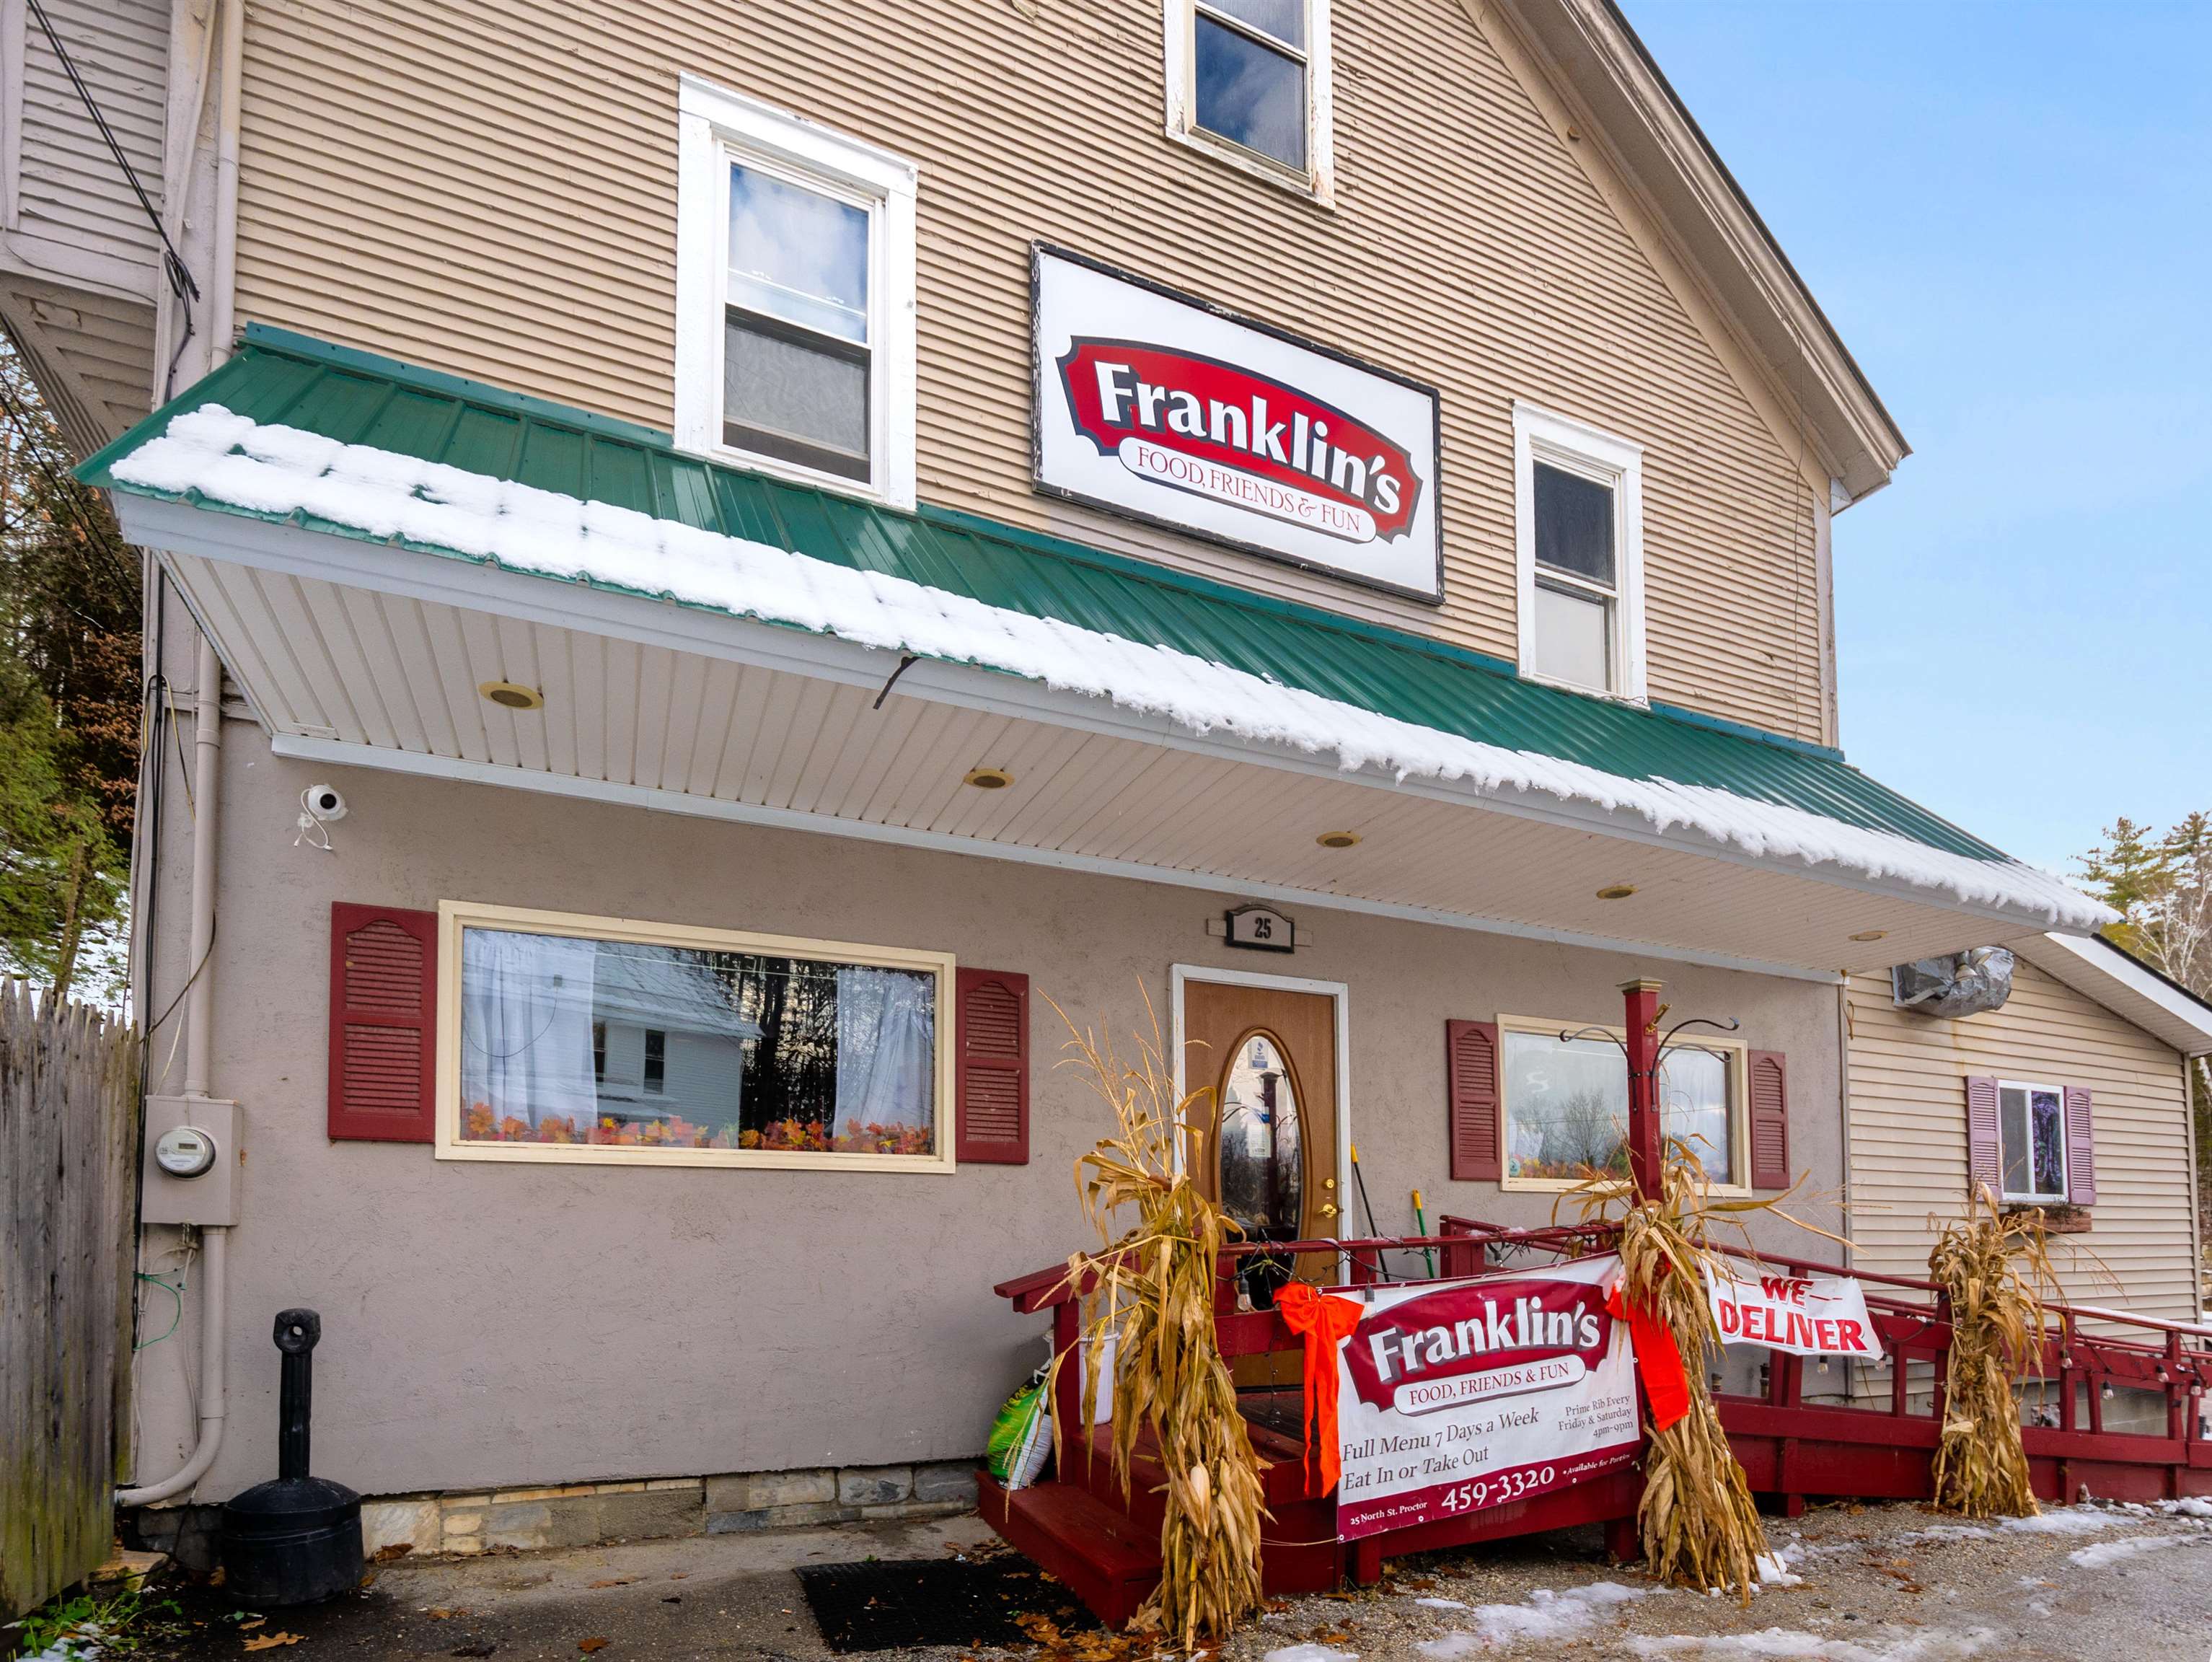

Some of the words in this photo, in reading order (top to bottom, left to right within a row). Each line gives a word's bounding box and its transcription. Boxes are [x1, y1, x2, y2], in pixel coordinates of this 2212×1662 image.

[1094, 360, 1401, 514] Franklin's
[1137, 445, 1205, 489] FOOD,
[1209, 468, 1295, 513] FRIENDS
[1297, 497, 1317, 517] &
[1321, 503, 1361, 534] FUN
[1254, 917, 1272, 939] 25
[1760, 1275, 1814, 1308] WE
[1368, 1296, 1600, 1382] Franklin's
[1718, 1298, 1868, 1351] DELIVER
[1409, 1384, 1456, 1405] FOOD,
[1459, 1370, 1522, 1395] FRIENDS
[1525, 1368, 1536, 1384] &
[1540, 1362, 1569, 1381] FUN
[1565, 1404, 1590, 1416] Prime
[1592, 1398, 1605, 1410] Rib
[1606, 1395, 1631, 1407] Every
[1342, 1438, 1375, 1462] Full
[1378, 1435, 1431, 1455] Menu
[1435, 1432, 1443, 1448] 7
[1446, 1424, 1482, 1443] Days
[1486, 1420, 1494, 1433] a
[1498, 1407, 1540, 1430] Week
[1558, 1417, 1587, 1431] Friday
[1588, 1415, 1595, 1425] &
[1597, 1407, 1632, 1422] Saturday
[1592, 1420, 1634, 1438] 4pm-9pm
[1344, 1472, 1372, 1491] Eat
[1377, 1467, 1393, 1484] In
[1398, 1465, 1418, 1479] or
[1422, 1454, 1459, 1474] Take
[1462, 1446, 1489, 1467] Out
[1441, 1466, 1555, 1512] 459-3320
[1349, 1516, 1360, 1526] 25
[1360, 1510, 1385, 1523] North
[1386, 1506, 1398, 1517] St.
[1399, 1501, 1428, 1514] Proctor
